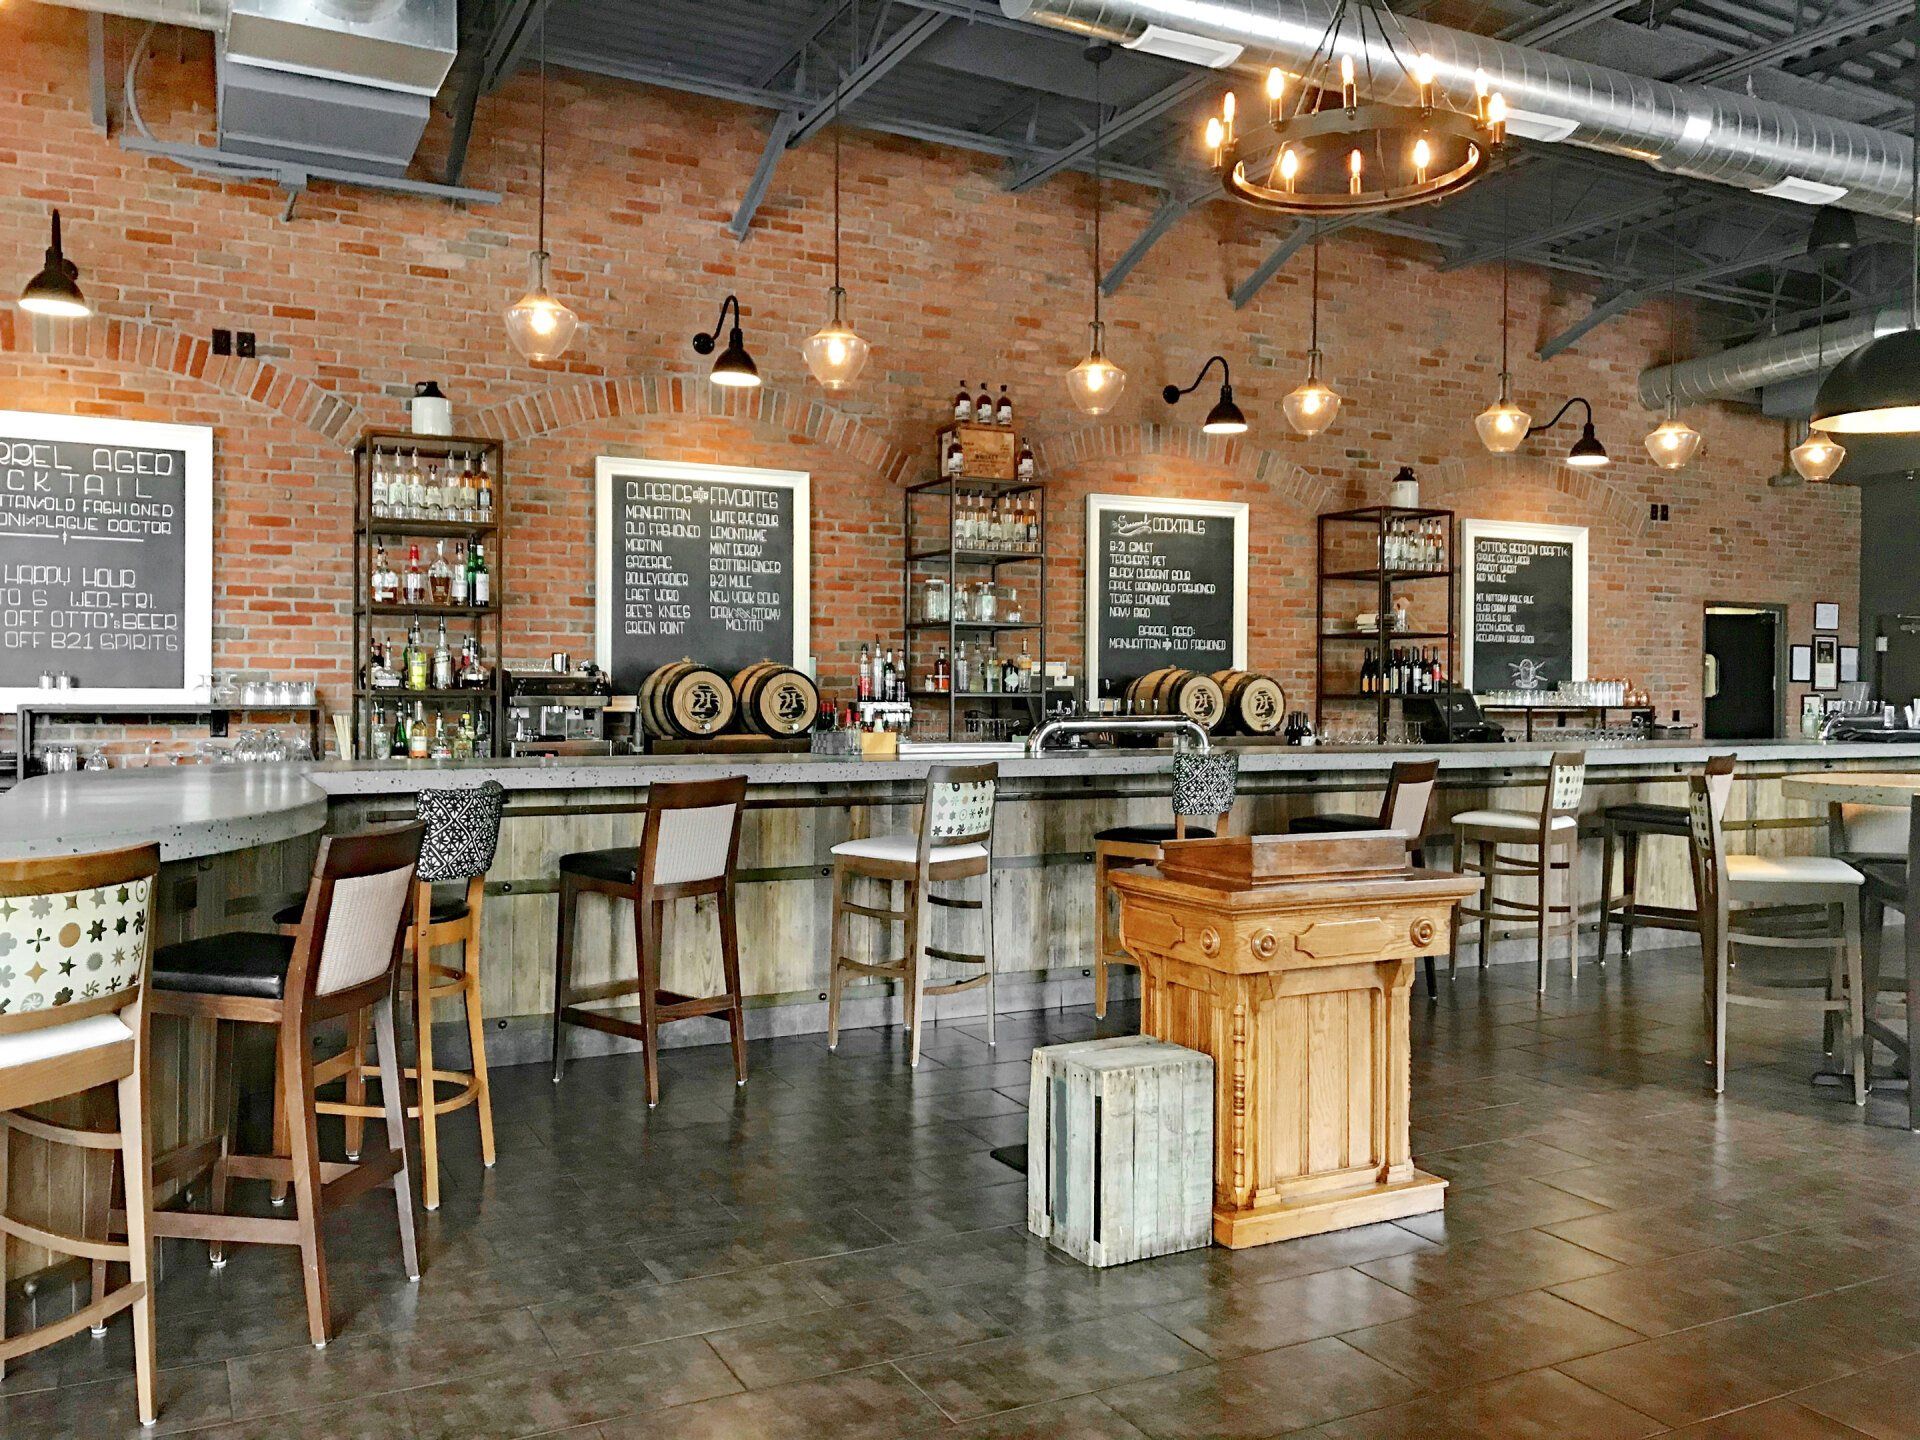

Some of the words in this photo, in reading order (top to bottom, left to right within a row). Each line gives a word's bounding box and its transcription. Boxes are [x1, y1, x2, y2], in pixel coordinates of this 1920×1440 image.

[92, 448, 173, 476] AGED
[626, 481, 692, 502] CLASSICS
[710, 486, 778, 509] FAVORITES
[44, 498, 75, 512] OLD
[83, 499, 173, 517] FASHIONED
[625, 505, 691, 521] MANHATTAN
[36, 515, 99, 530] PLAGUE
[108, 519, 171, 534] DOCTOR
[710, 509, 736, 524] WHITE
[738, 512, 754, 525] RYE
[756, 513, 779, 527] SOUR
[625, 521, 645, 535] OLD
[649, 523, 701, 538] FASHIONED
[1153, 517, 1206, 535] COCKTAILS
[625, 538, 662, 553] MARTINI
[710, 542, 731, 555] MINT
[733, 543, 762, 557] DERBY
[625, 555, 672, 570] SAZERAC
[710, 558, 750, 572] SCOTTISH
[752, 560, 781, 574] GINGER
[1152, 556, 1166, 566] PET
[4, 564, 70, 586] HAPPY
[83, 568, 136, 588] HOUR
[625, 571, 688, 586] BOULEVARDIER
[729, 575, 752, 588] MULE
[1109, 567, 1134, 578] BLACK
[1171, 569, 1191, 581] SOUR
[625, 588, 650, 602] LAST
[655, 589, 680, 602] WORD
[1109, 580, 1133, 591] APPLE
[1162, 582, 1175, 593] OLD
[1177, 583, 1215, 595] FASHIONED
[33, 589, 47, 606] 6
[710, 590, 730, 603] NEW
[732, 591, 755, 603] YORK
[756, 592, 780, 605] SOUR
[1110, 593, 1133, 604] TEXAS
[625, 604, 653, 618] BEE'S
[659, 605, 691, 619] KNEES
[710, 606, 733, 619] DARK
[751, 607, 781, 620] STORMY
[1109, 606, 1131, 618] NAVY
[1133, 607, 1151, 618] BIRD
[5, 610, 44, 627] OFF
[123, 613, 178, 630] BEER
[725, 619, 764, 632] MOJITO
[625, 621, 655, 635] GREEN
[659, 621, 686, 635] POINT
[1138, 625, 1169, 636] BARREL
[5, 631, 45, 648] OFF
[51, 632, 94, 649] B21
[100, 633, 178, 651] SPIRITS
[1109, 637, 1162, 649] MANHATTAN
[1173, 638, 1188, 650] OLD
[1190, 639, 1226, 650] FASHIONED
